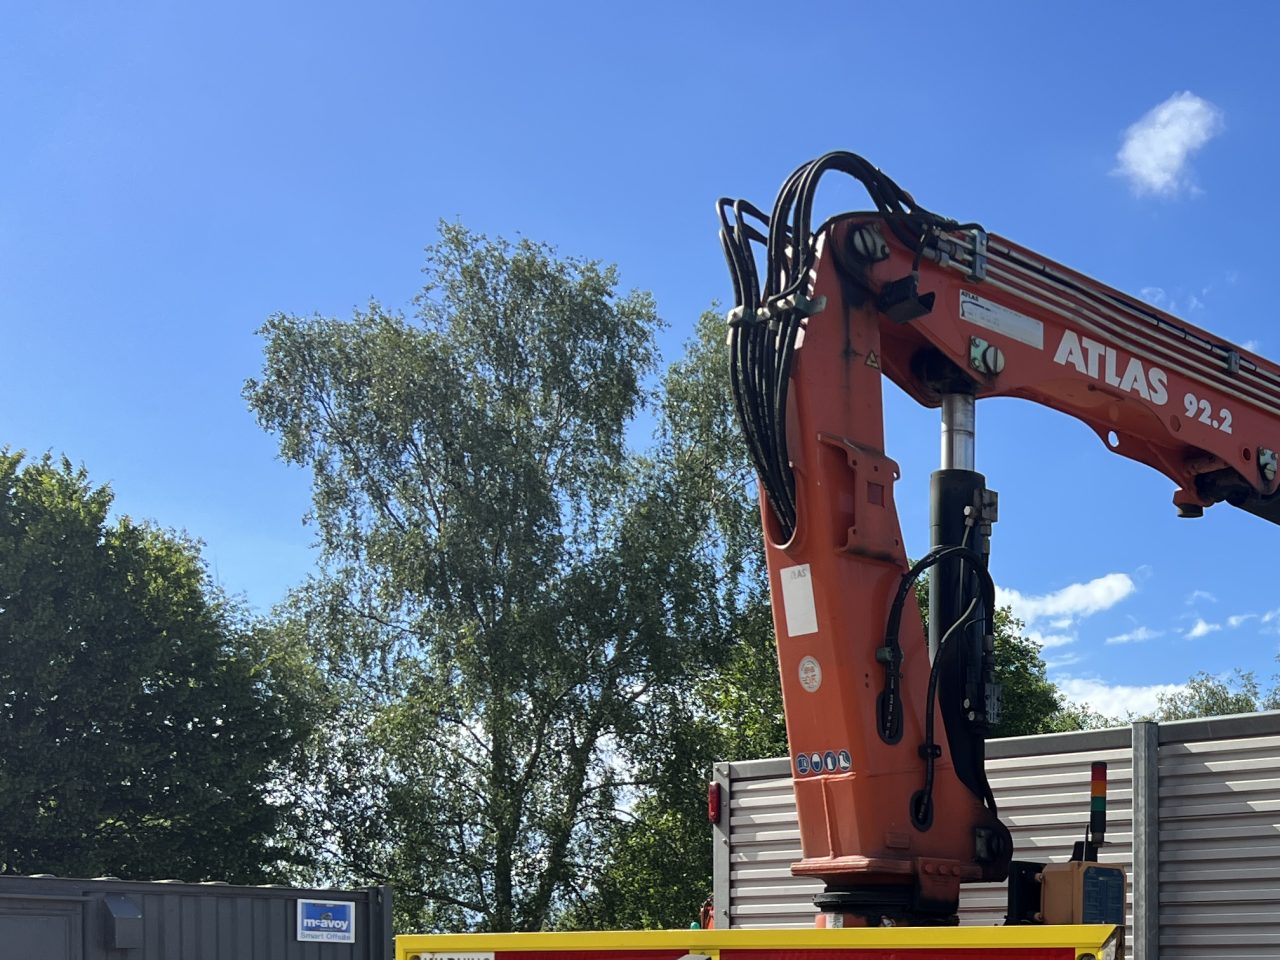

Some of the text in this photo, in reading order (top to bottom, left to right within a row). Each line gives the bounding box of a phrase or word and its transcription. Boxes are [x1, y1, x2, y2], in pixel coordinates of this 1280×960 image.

[1053, 329, 1233, 434] ATLAS 92.2
[300, 932, 325, 940] Smart
